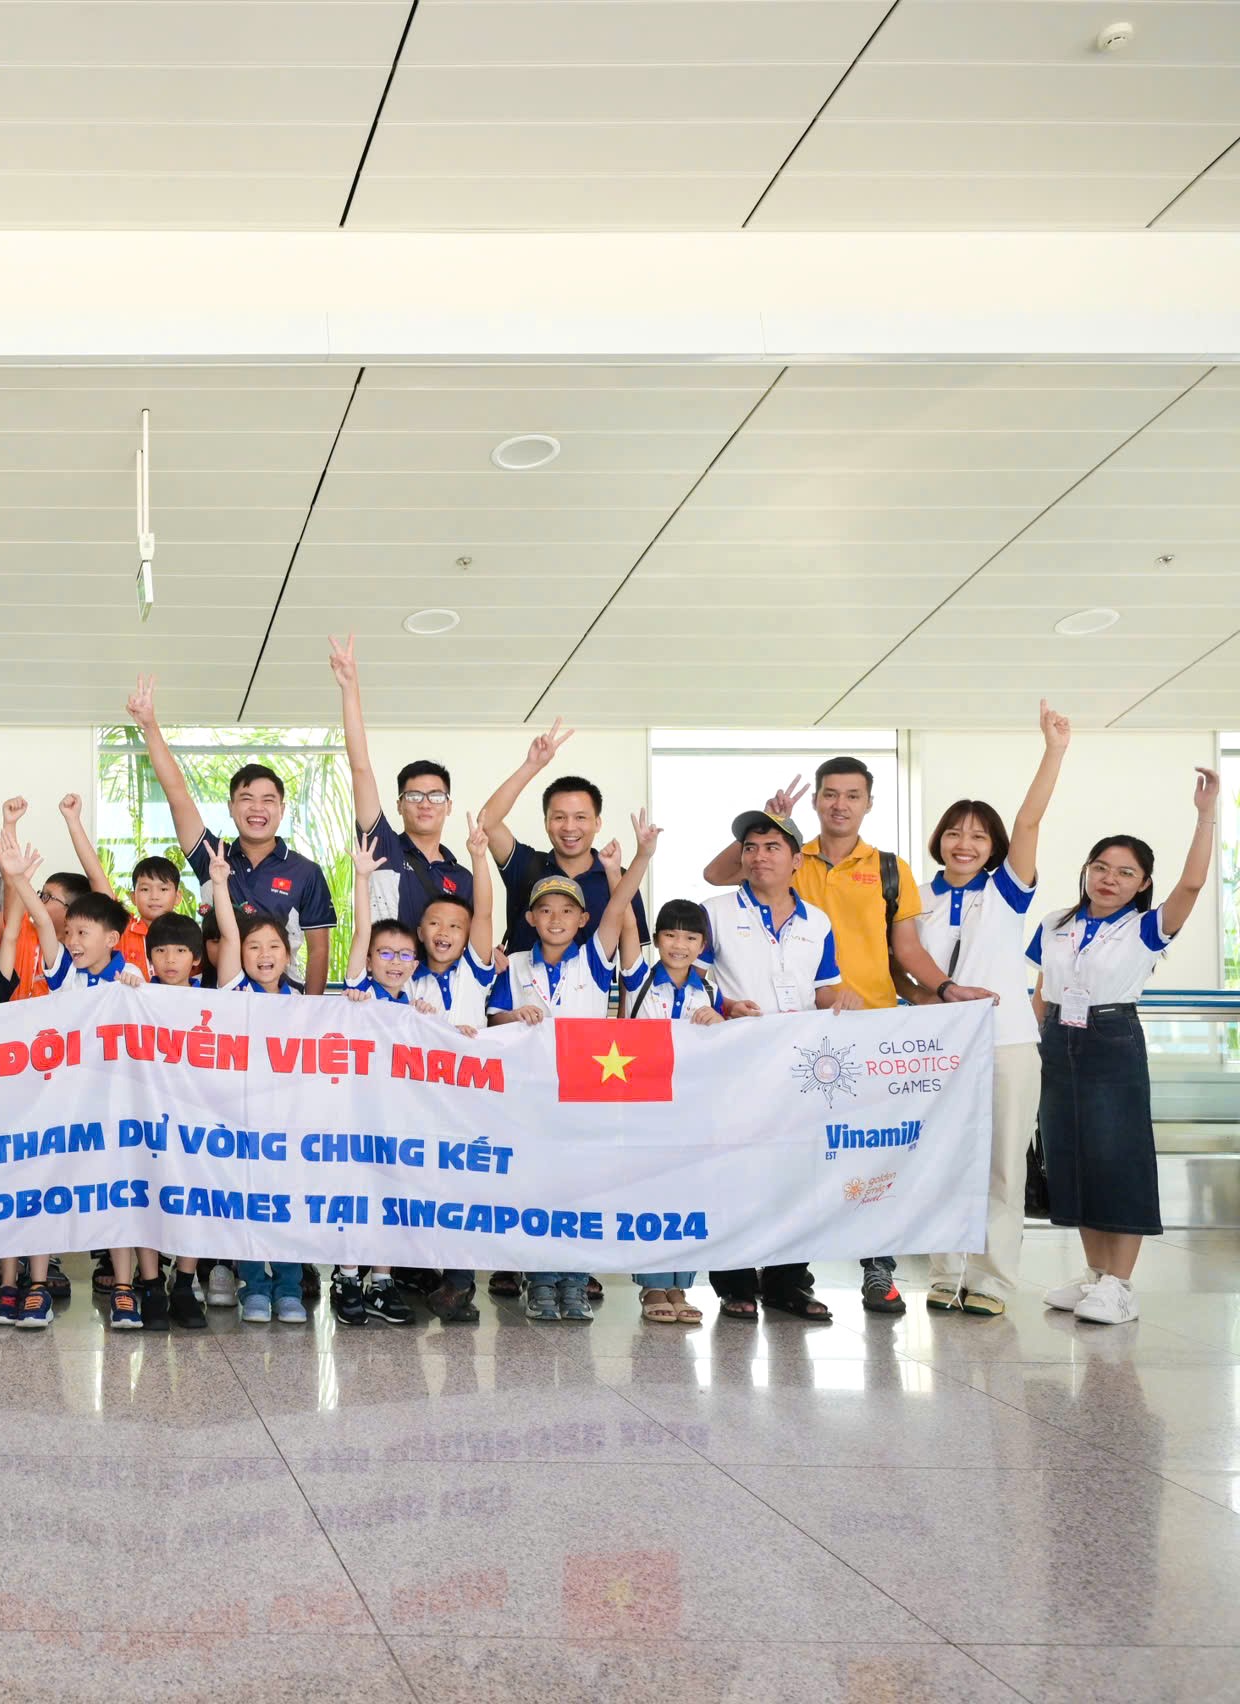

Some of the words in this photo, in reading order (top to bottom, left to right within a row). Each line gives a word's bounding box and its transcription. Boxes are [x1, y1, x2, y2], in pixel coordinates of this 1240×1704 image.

[96, 1009, 250, 1072] TUYỂN
[266, 1032, 376, 1085] VIỆT
[391, 1043, 505, 1093] NAM
[878, 1038, 944, 1054] GLOBAL
[865, 1055, 960, 1076] ROBOTICS
[888, 1078, 942, 1095] GAMES
[118, 1112, 170, 1158] DỰ
[177, 1123, 288, 1161] VÒNG
[300, 1133, 425, 1168] CHUNG
[438, 1135, 514, 1175] KẾT
[825, 1151, 837, 1160] EST
[159, 1185, 292, 1224] GAMES
[304, 1194, 369, 1232] TẠI
[381, 1197, 604, 1241] SINGAPORE
[615, 1210, 709, 1242] 2024
